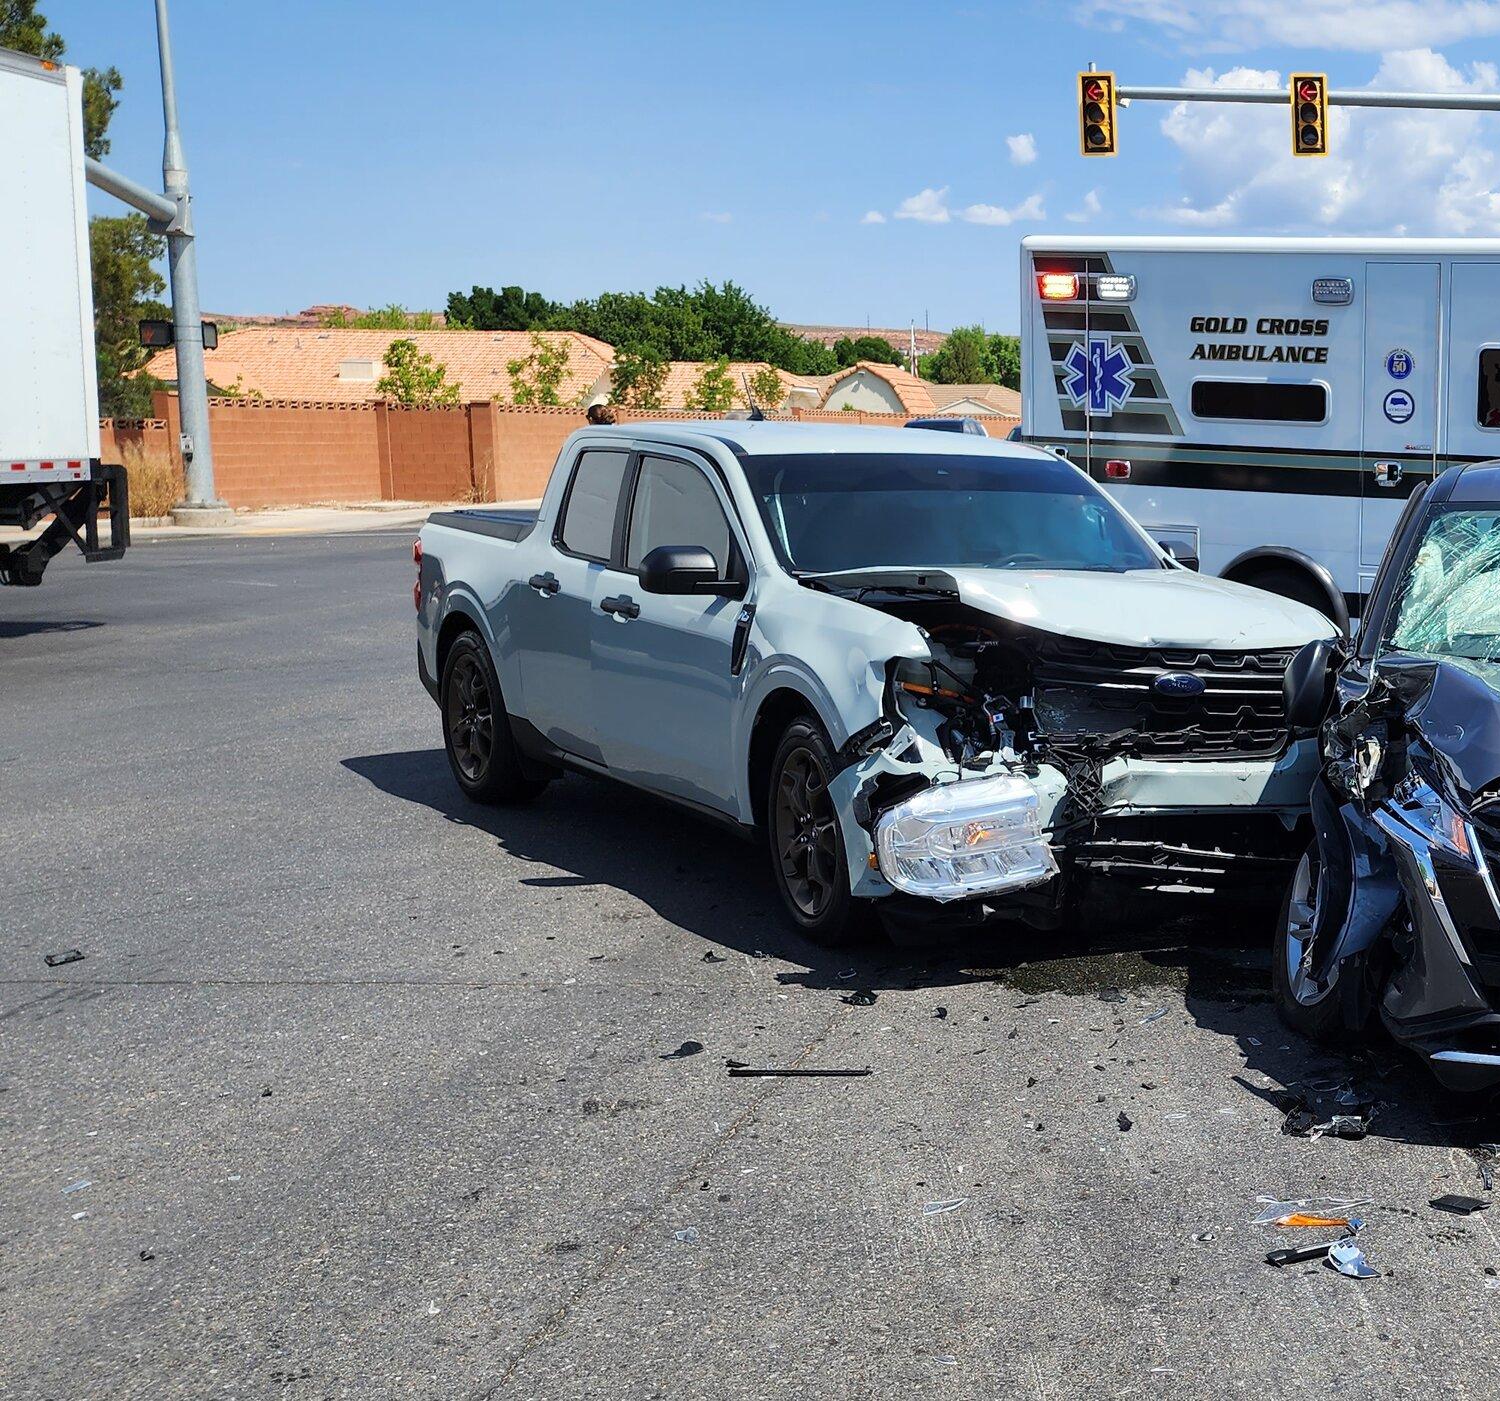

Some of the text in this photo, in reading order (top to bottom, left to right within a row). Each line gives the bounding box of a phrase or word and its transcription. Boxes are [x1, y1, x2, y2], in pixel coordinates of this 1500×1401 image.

[1190, 316, 1329, 336] GOLD CROSS
[1189, 343, 1329, 364] AMBULANCE
